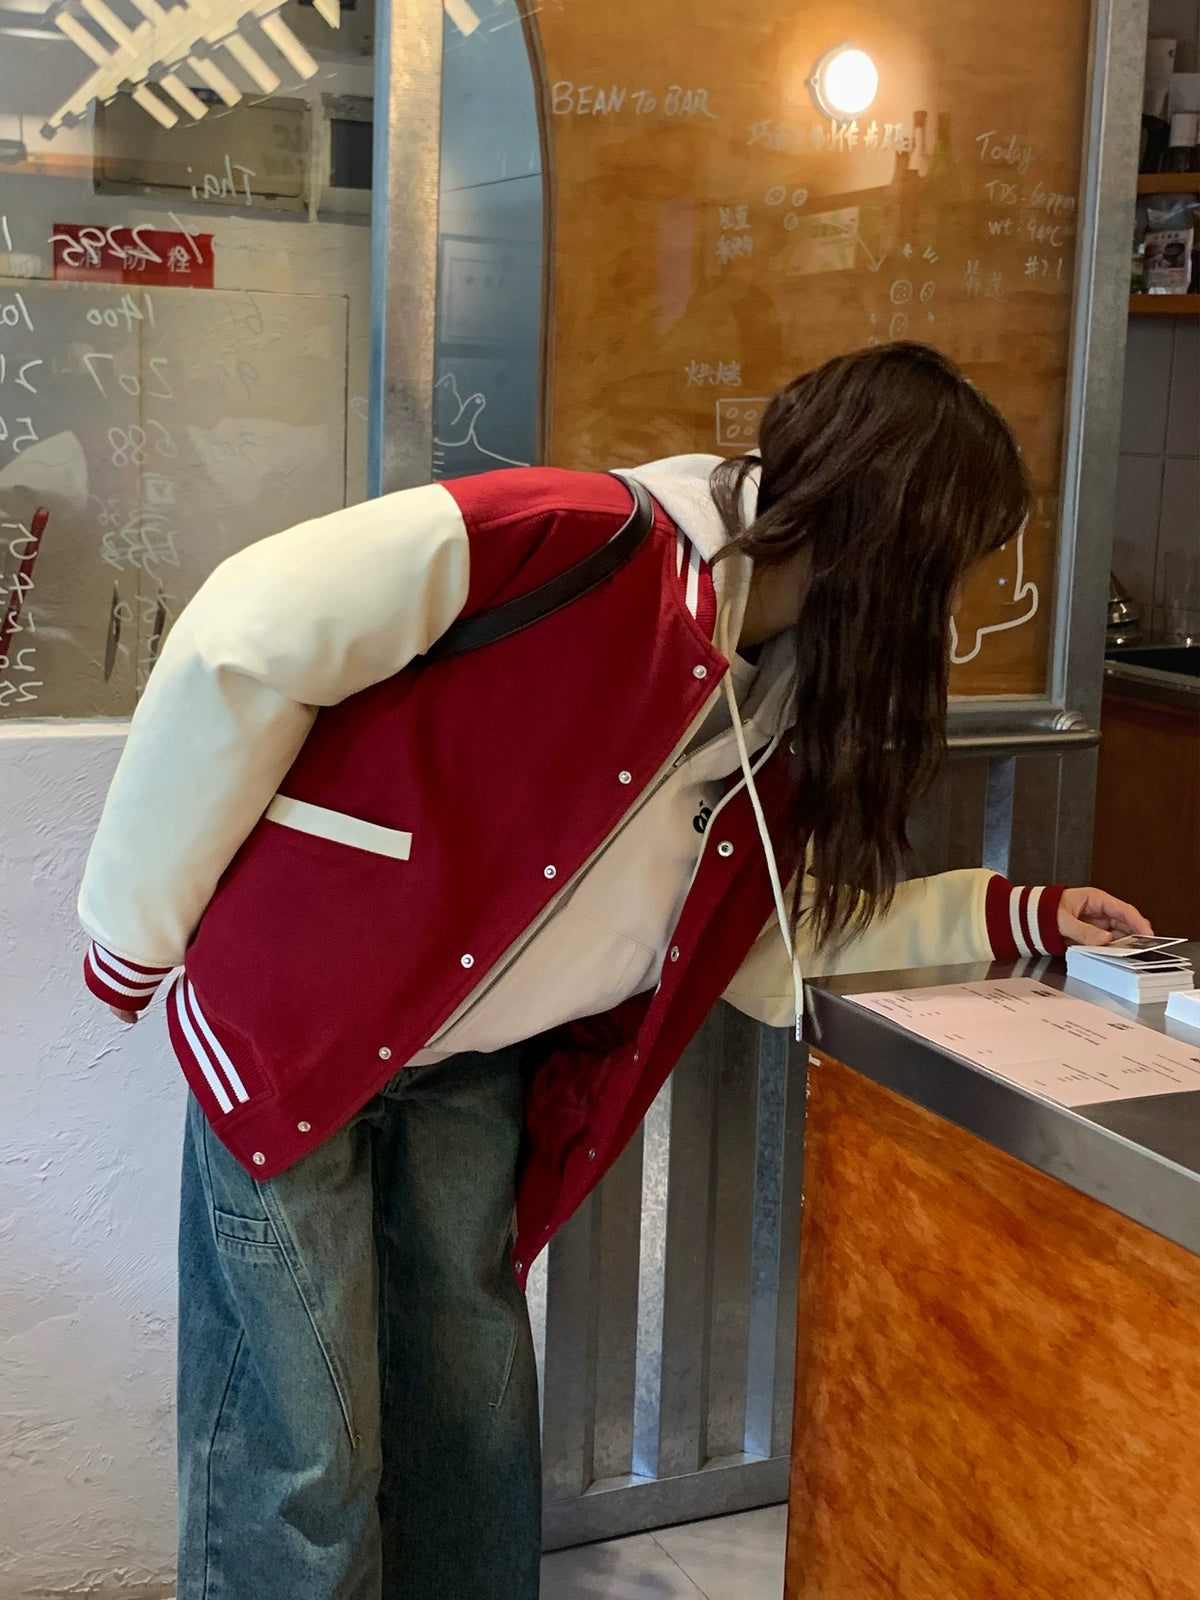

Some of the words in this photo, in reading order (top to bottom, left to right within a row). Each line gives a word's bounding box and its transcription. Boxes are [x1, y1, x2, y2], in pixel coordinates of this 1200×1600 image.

[551, 81, 627, 116] BEAN
[664, 85, 718, 119] BAR
[975, 129, 1032, 175] Today
